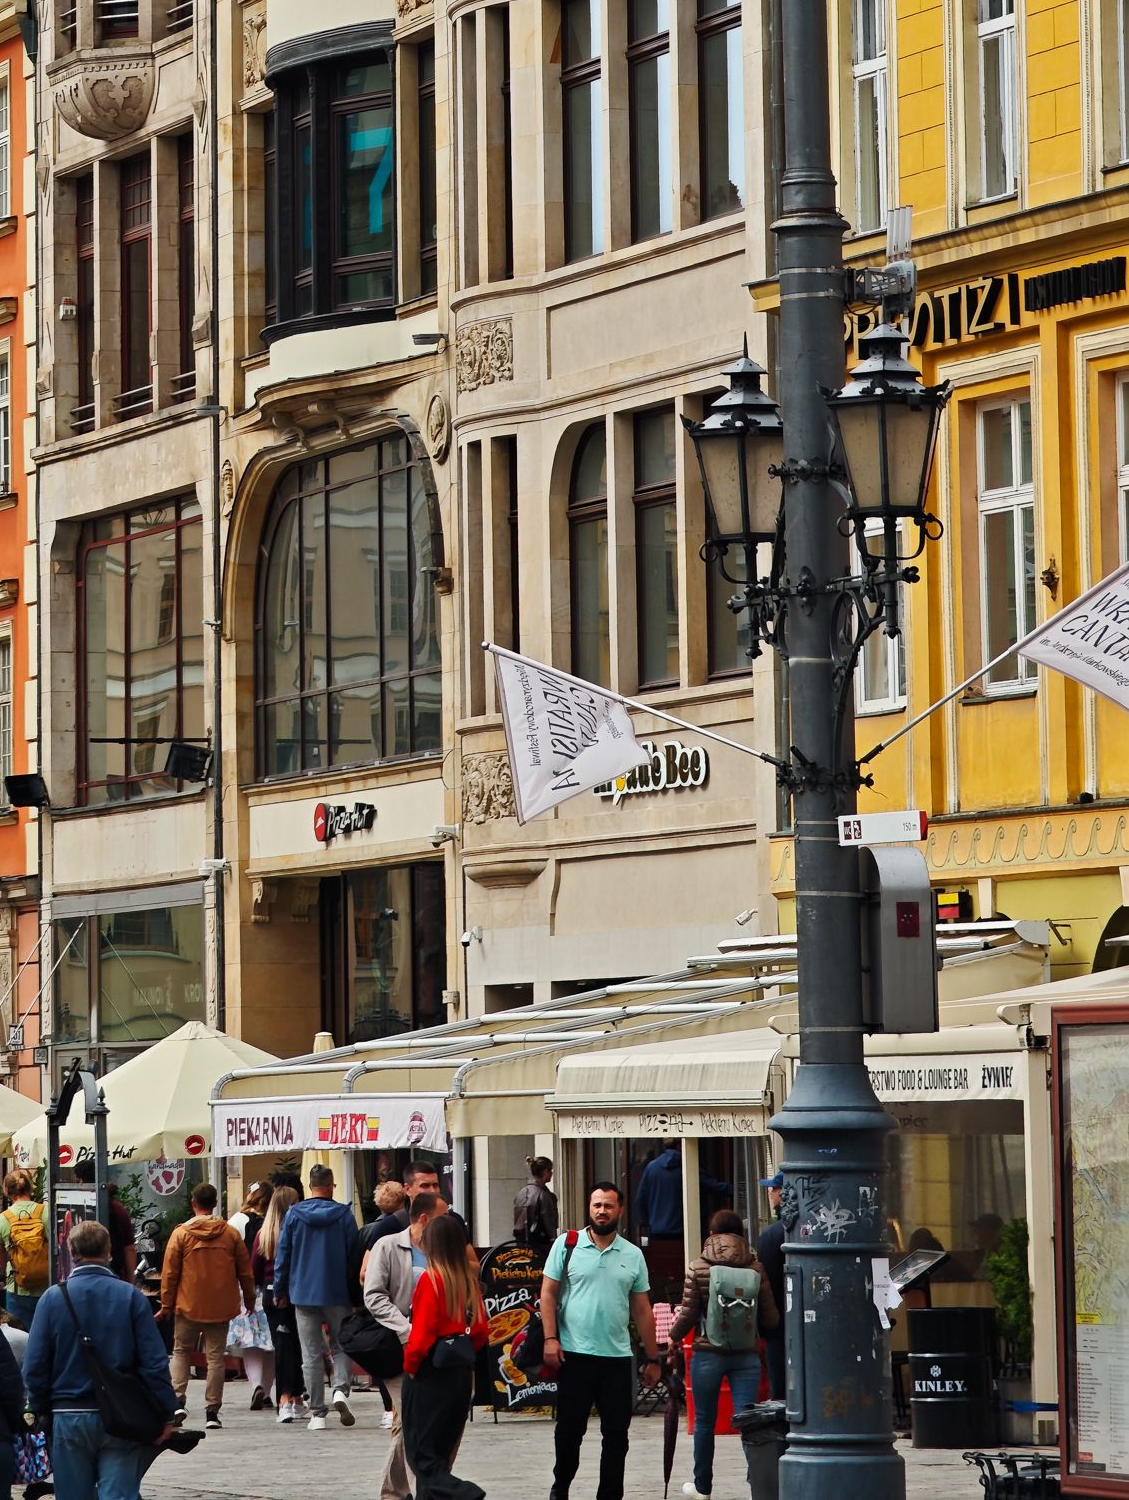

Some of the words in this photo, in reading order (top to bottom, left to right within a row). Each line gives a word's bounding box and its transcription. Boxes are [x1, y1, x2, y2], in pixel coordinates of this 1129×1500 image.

[666, 742, 705, 788] Bee
[897, 1069, 916, 1090] FOOD
[924, 1068, 953, 1090] LOUNGE
[953, 1067, 969, 1090] BAR
[226, 1115, 294, 1147] PIEKARNIA
[76, 1145, 111, 1163] Piz
[112, 1144, 138, 1160] Hut
[484, 1287, 532, 1318] Pizza
[914, 1380, 965, 1392] KINLEY
